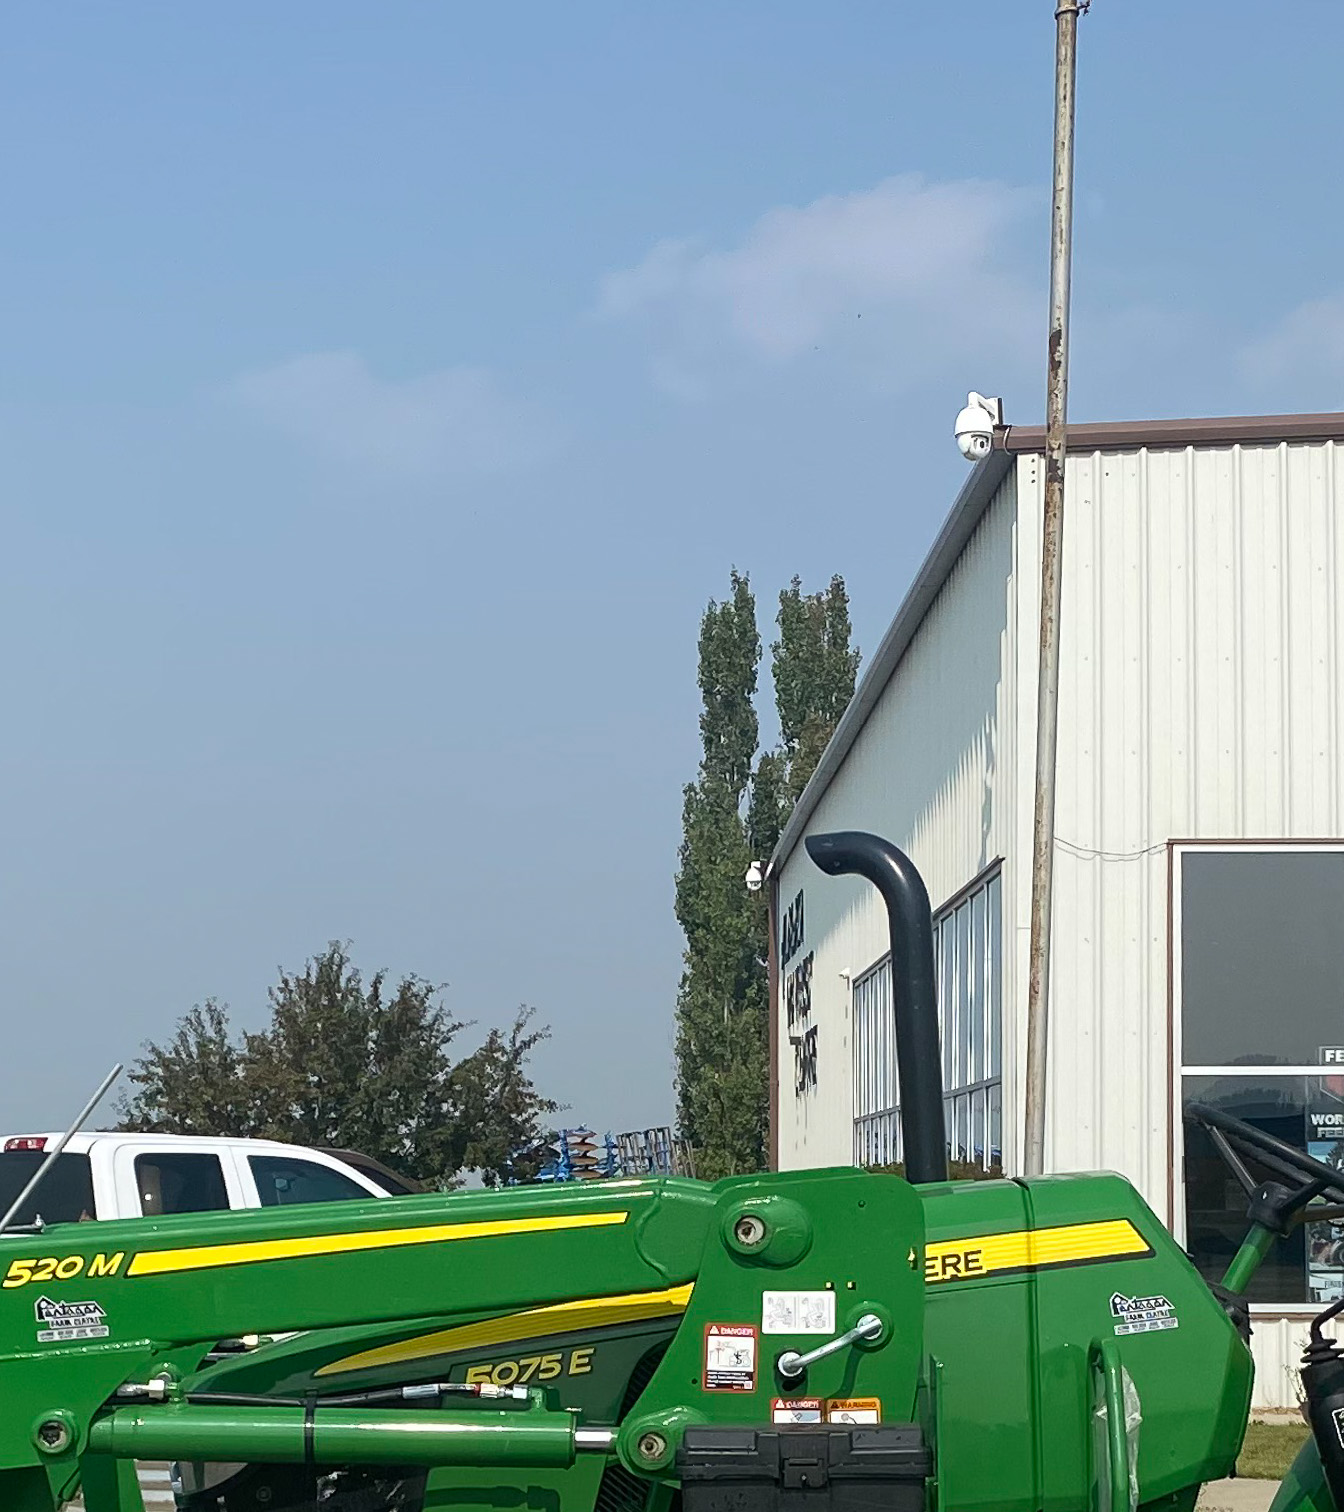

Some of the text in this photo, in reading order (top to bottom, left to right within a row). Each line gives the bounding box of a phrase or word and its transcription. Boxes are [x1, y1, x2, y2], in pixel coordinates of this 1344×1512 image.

[1, 1252, 125, 1289] 520 M
[720, 1326, 754, 1336] DANGER
[465, 1347, 595, 1386] 5075 E
[785, 1399, 820, 1409] DANGER
